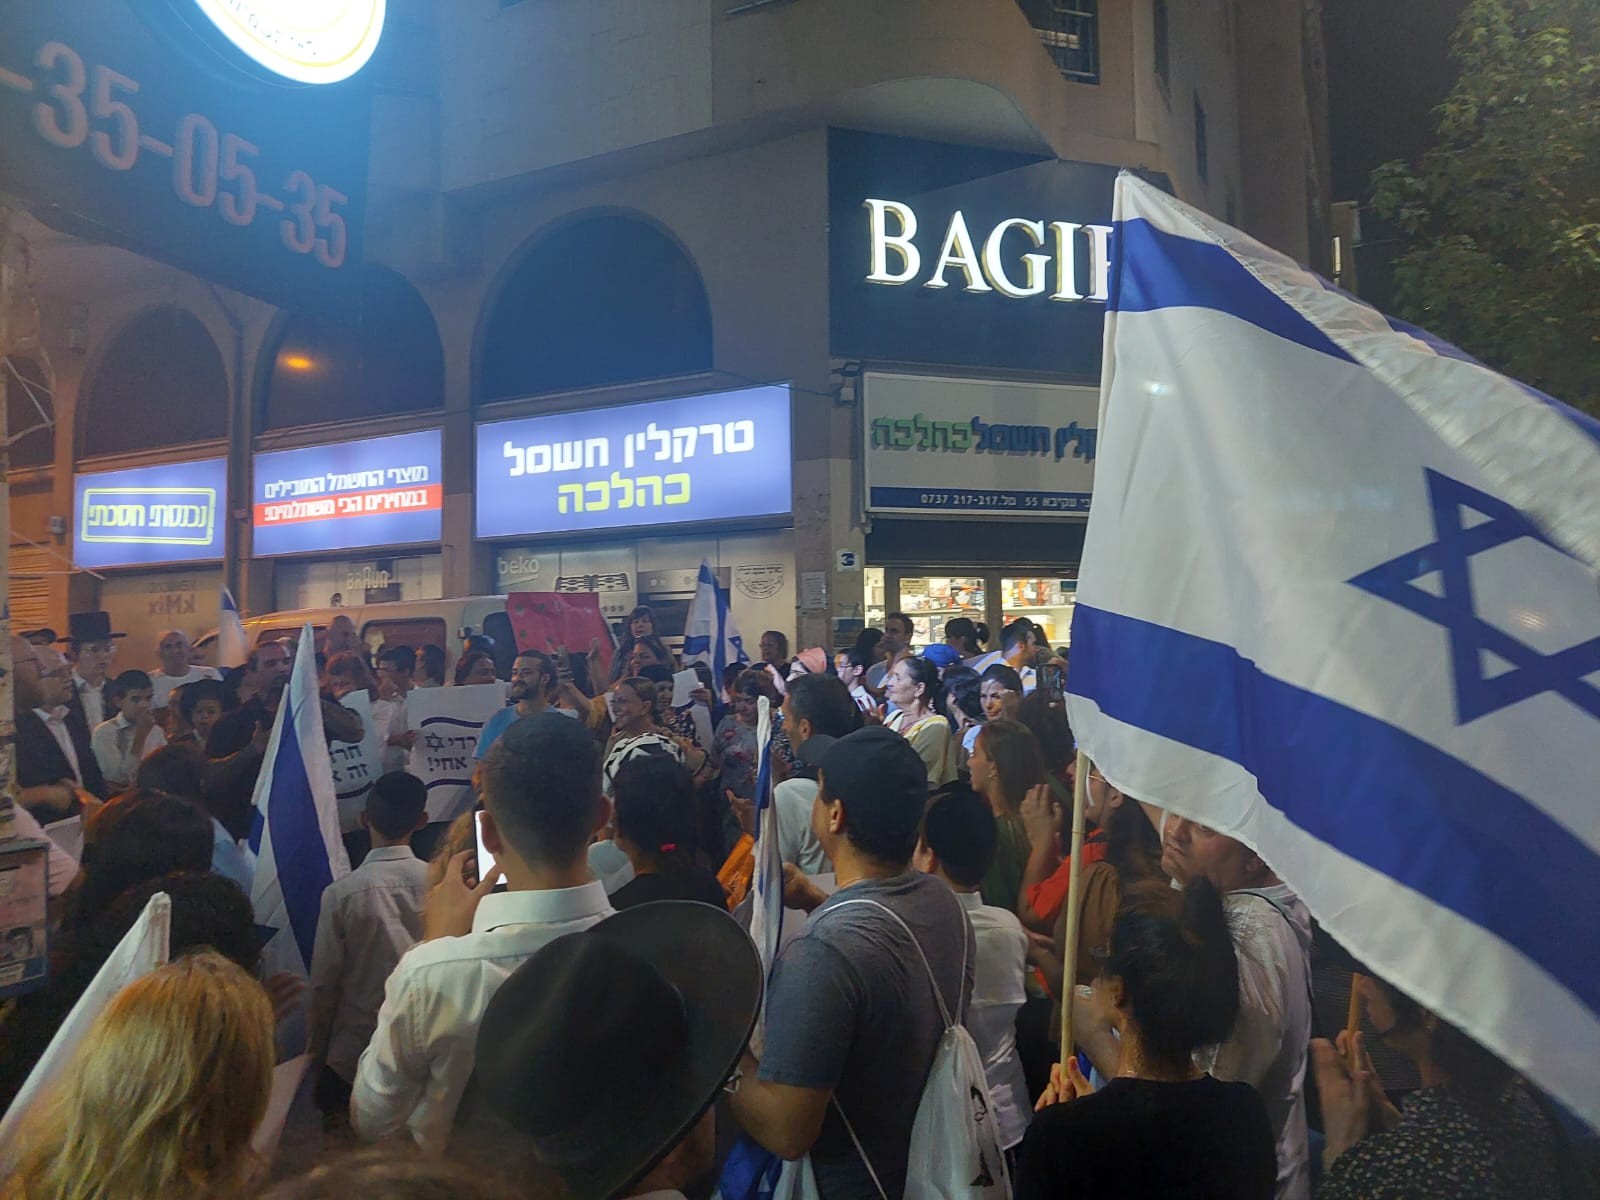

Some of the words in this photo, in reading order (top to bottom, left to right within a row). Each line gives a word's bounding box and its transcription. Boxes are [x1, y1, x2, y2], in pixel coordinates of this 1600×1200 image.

[624, 420, 754, 468] טרקלין
[558, 471, 690, 513] כהלכה
[920, 494, 949, 505] 0737
[497, 556, 540, 575] beko
[841, 552, 855, 567] 3
